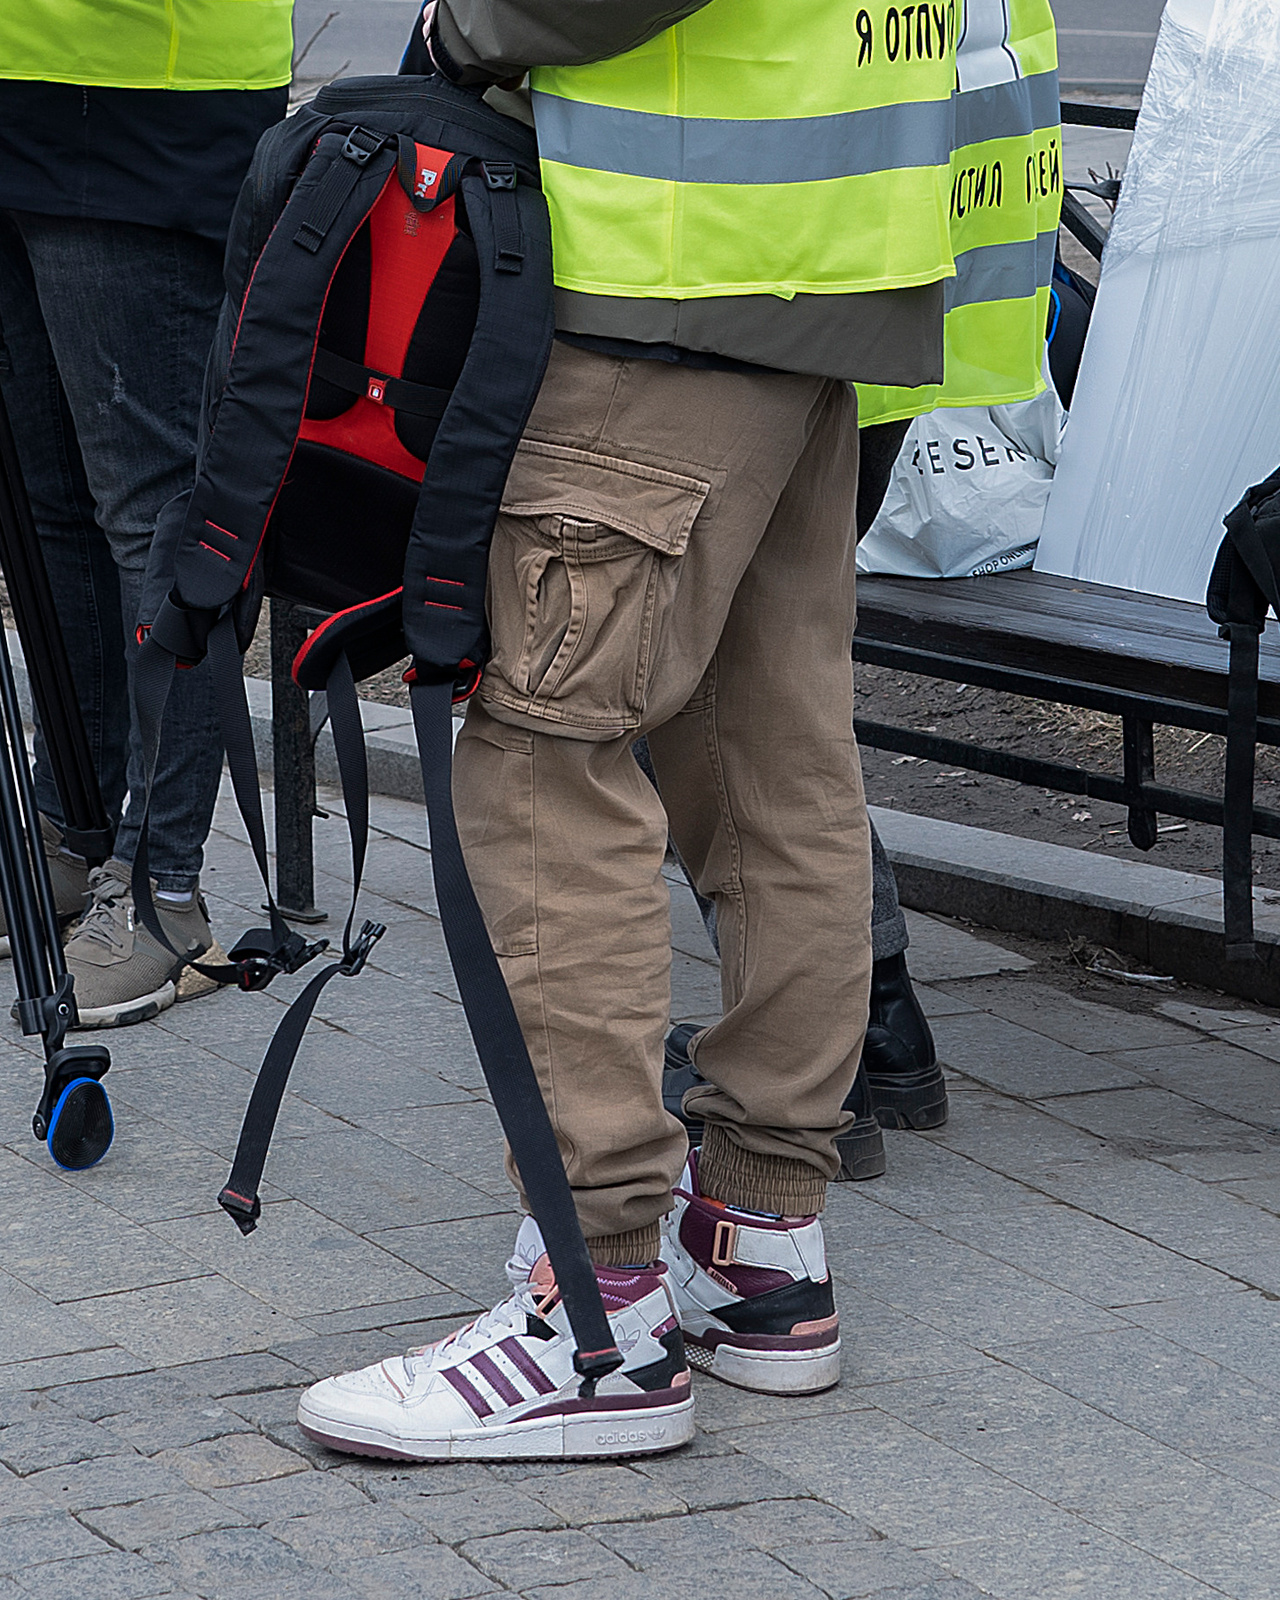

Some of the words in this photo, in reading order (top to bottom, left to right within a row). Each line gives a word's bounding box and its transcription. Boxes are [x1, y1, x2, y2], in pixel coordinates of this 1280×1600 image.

[856, 9, 872, 67] Я
[972, 560, 999, 578] SHOP
[595, 1429, 647, 1445] adidas
